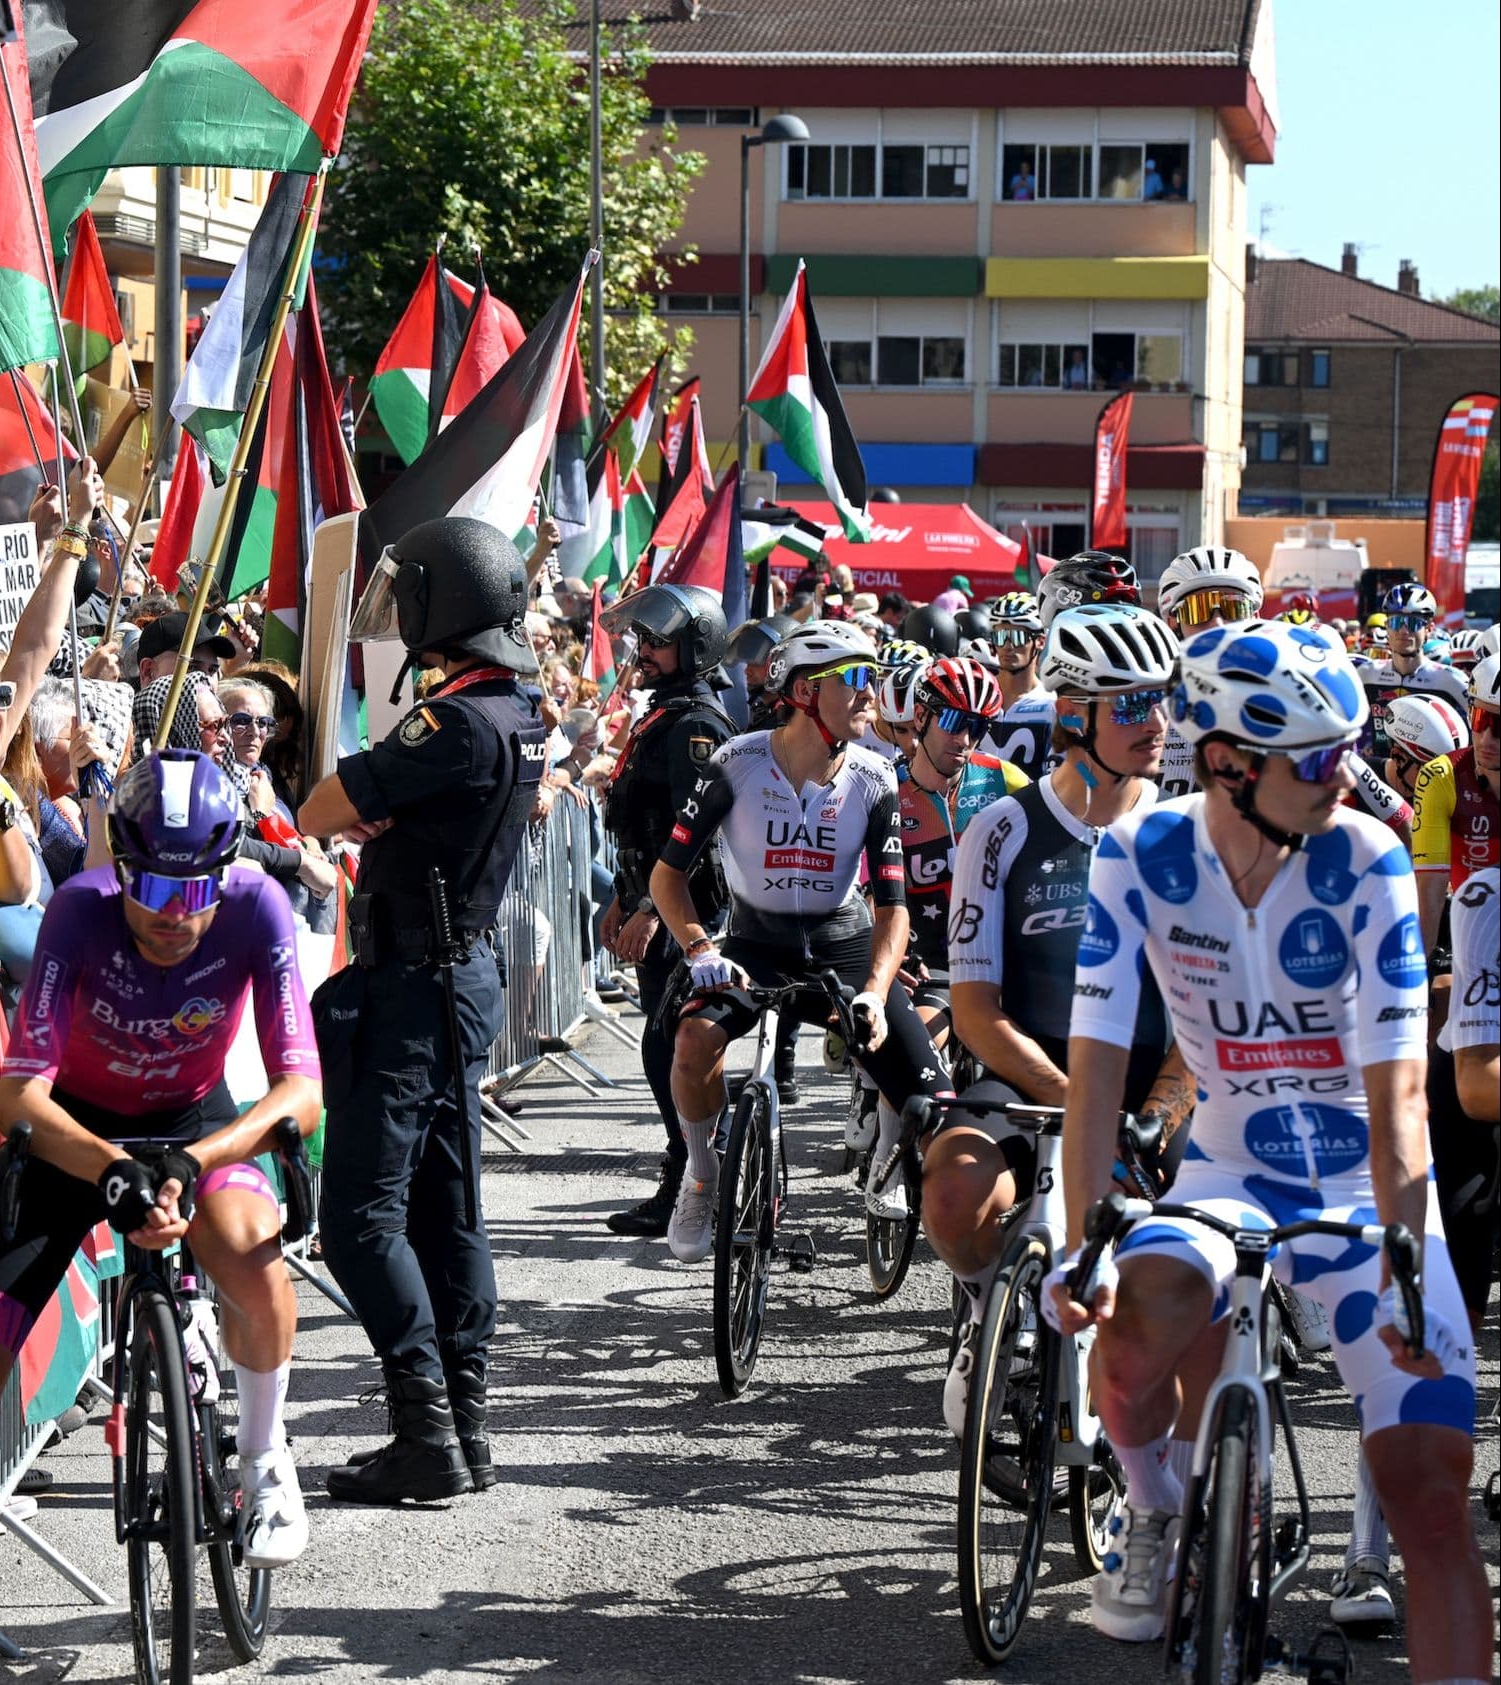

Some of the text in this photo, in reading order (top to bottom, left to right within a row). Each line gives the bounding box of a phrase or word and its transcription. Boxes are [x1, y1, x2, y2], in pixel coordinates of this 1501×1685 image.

[5, 564, 36, 593] MAR
[851, 570, 902, 587] FICIAL
[1164, 742, 1186, 750] vex
[1361, 768, 1393, 808] BOSS
[766, 820, 836, 851] UAE
[1462, 815, 1490, 870] fidis
[771, 853, 829, 869] Emirates
[763, 877, 834, 893] XRG
[1046, 882, 1082, 901] UBS
[1168, 925, 1231, 954] Santini
[36, 960, 60, 1019] CORTIZO
[1076, 982, 1114, 1000] ntini
[279, 972, 299, 1036] CORTIZO
[1207, 998, 1336, 1038] UAE
[1459, 1019, 1500, 1029] BREITL
[1227, 1046, 1331, 1067] Emirates
[1226, 1074, 1349, 1096] XRG
